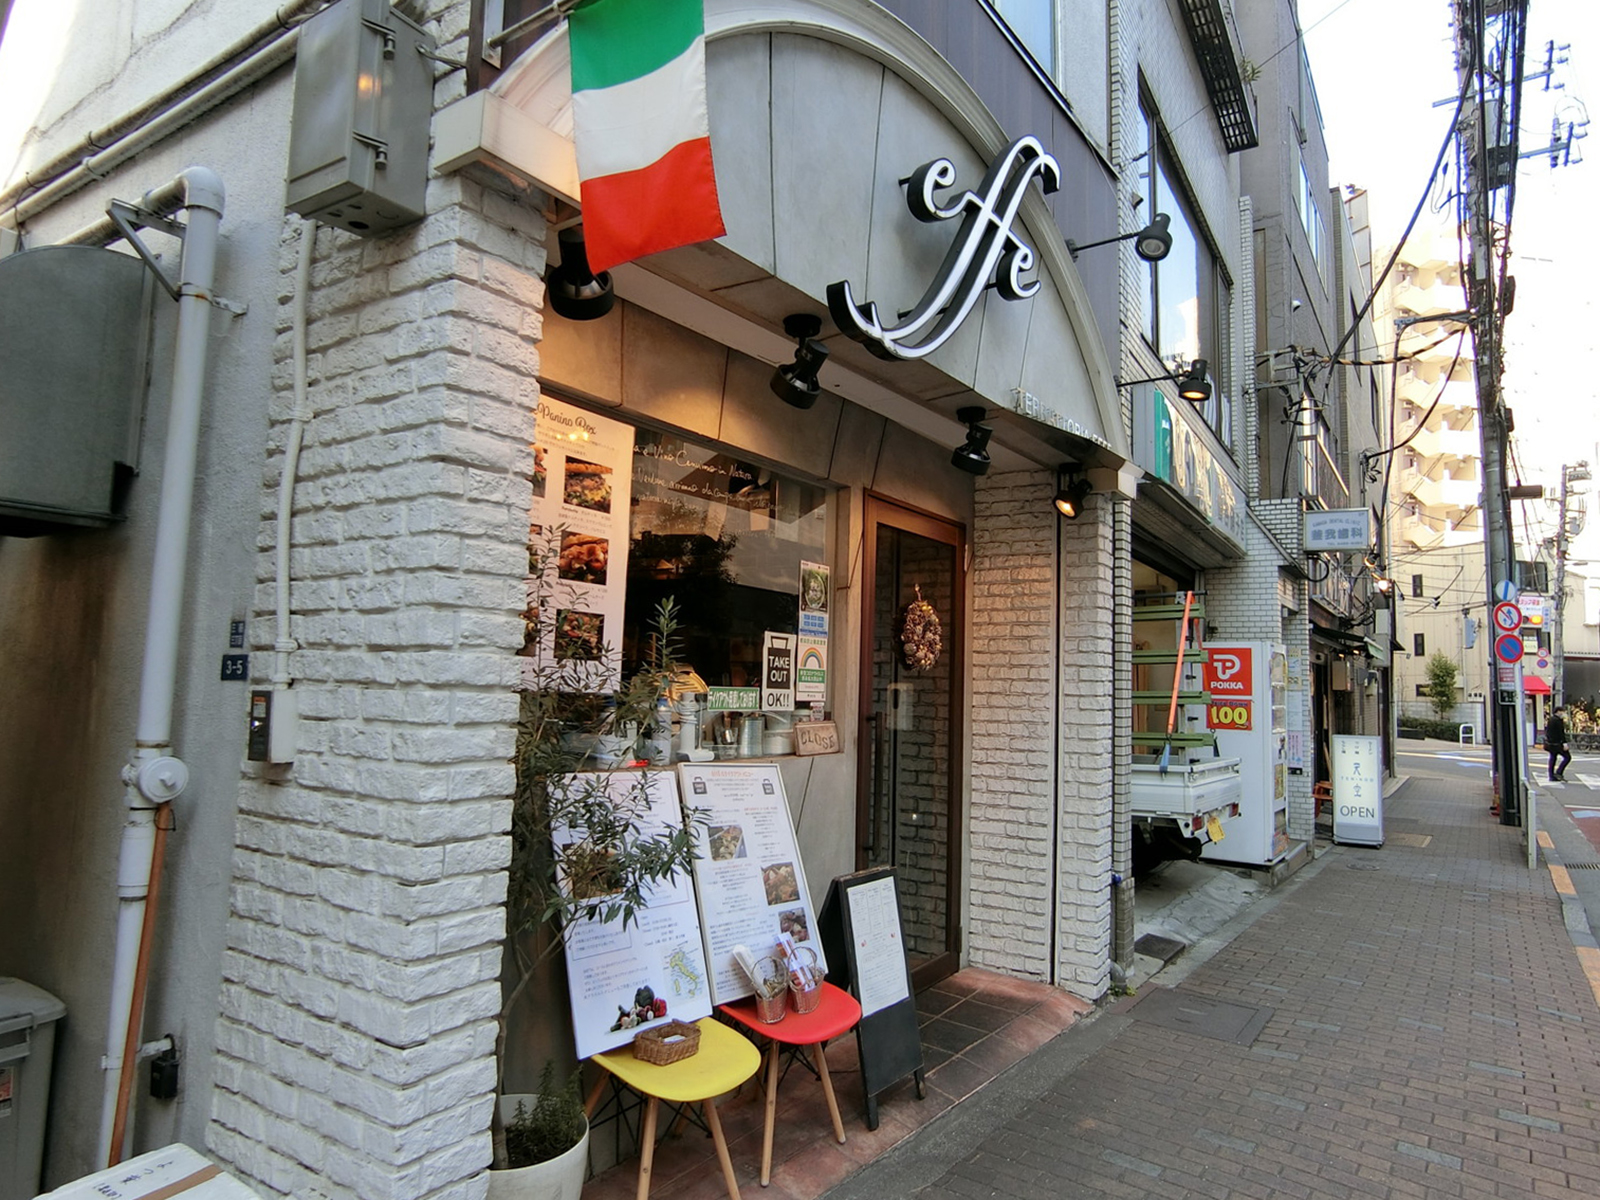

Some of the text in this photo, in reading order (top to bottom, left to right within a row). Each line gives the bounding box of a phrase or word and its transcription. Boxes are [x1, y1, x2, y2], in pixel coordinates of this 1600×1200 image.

[225, 660, 244, 675] 3-5
[769, 656, 790, 669] TAKE
[770, 670, 788, 682] OUT
[1210, 681, 1244, 690] POKKA
[767, 692, 790, 707] OK!!
[800, 731, 835, 750] CLOSE
[1340, 804, 1375, 819] OPEN
